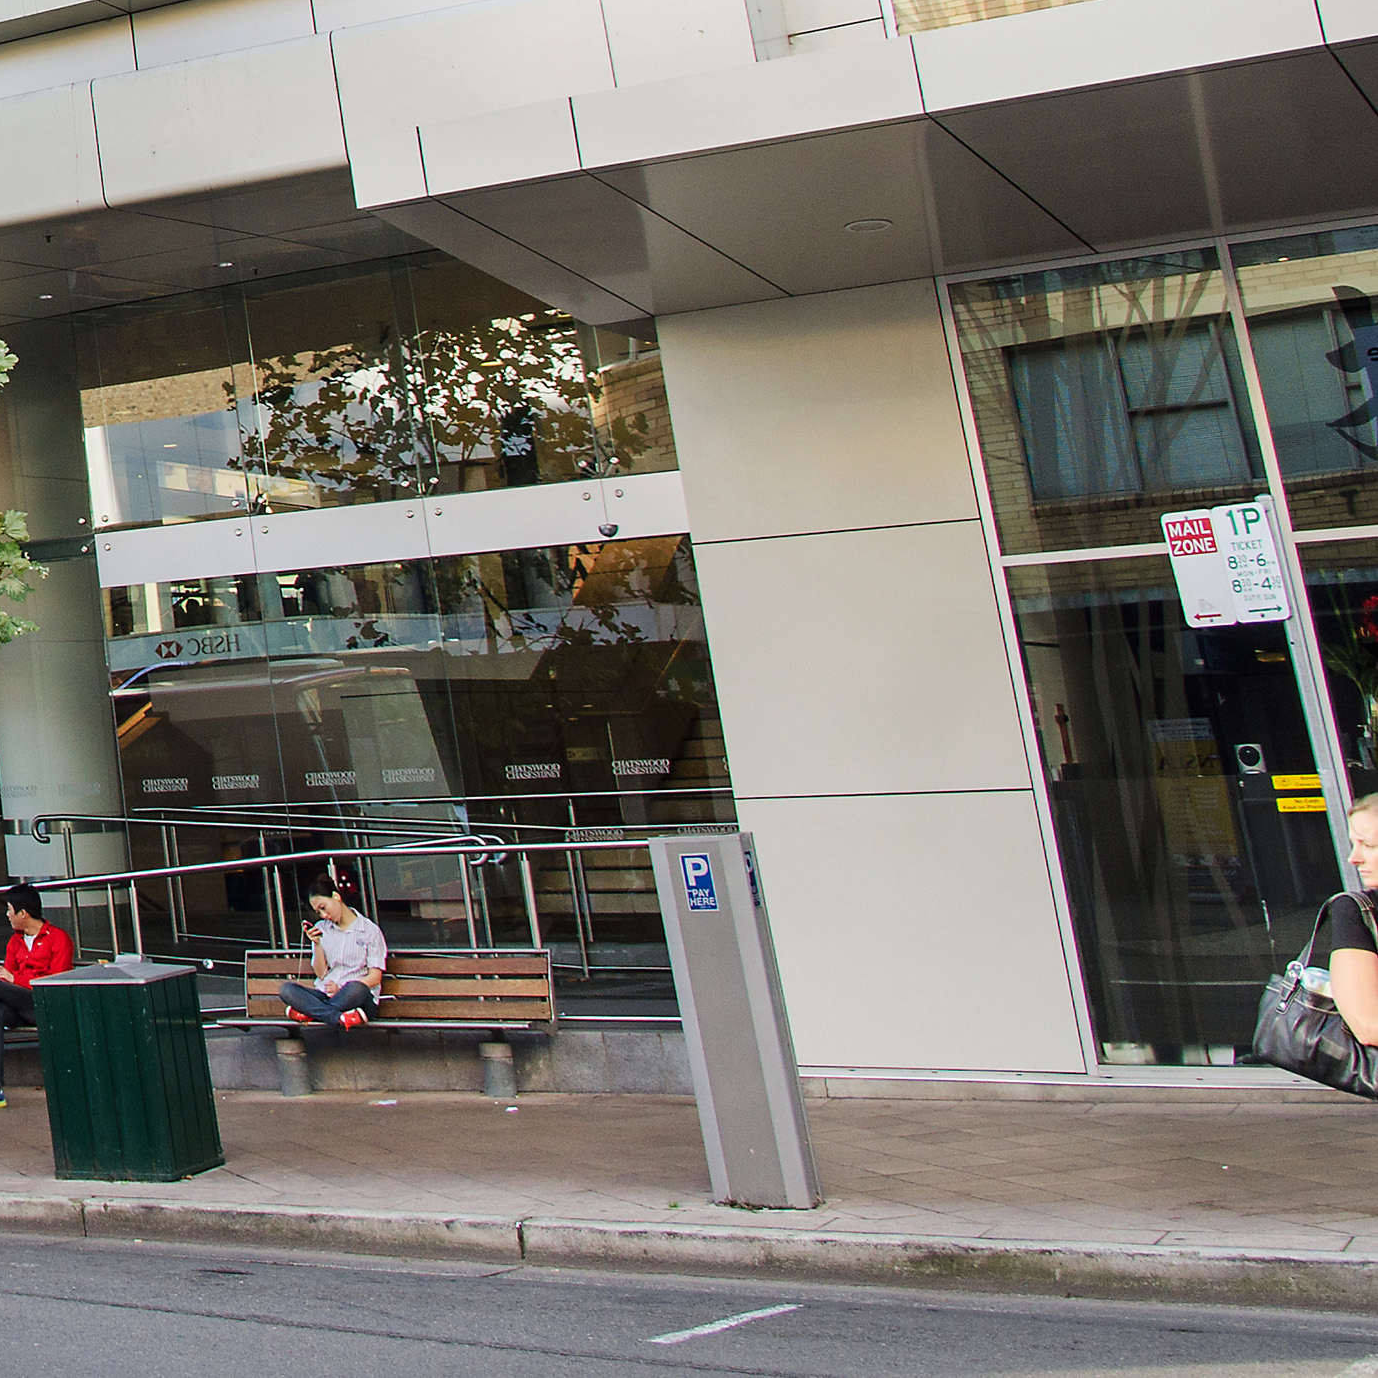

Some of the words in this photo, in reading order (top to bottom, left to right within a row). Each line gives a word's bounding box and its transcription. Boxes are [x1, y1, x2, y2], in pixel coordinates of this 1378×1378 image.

[1226, 508, 1261, 536] 1P
[1167, 520, 1211, 538] MAIL
[1171, 537, 1216, 556] ZONE
[1231, 539, 1263, 551] TICKET
[505, 763, 561, 772] CHATSWOOD
[612, 758, 670, 768] CHATSWOOD
[211, 775, 260, 784] CHATSWOOD
[305, 771, 356, 780] CHATSWOOD
[684, 857, 708, 886] P
[692, 889, 710, 898] PAY
[690, 897, 716, 906] HERE
